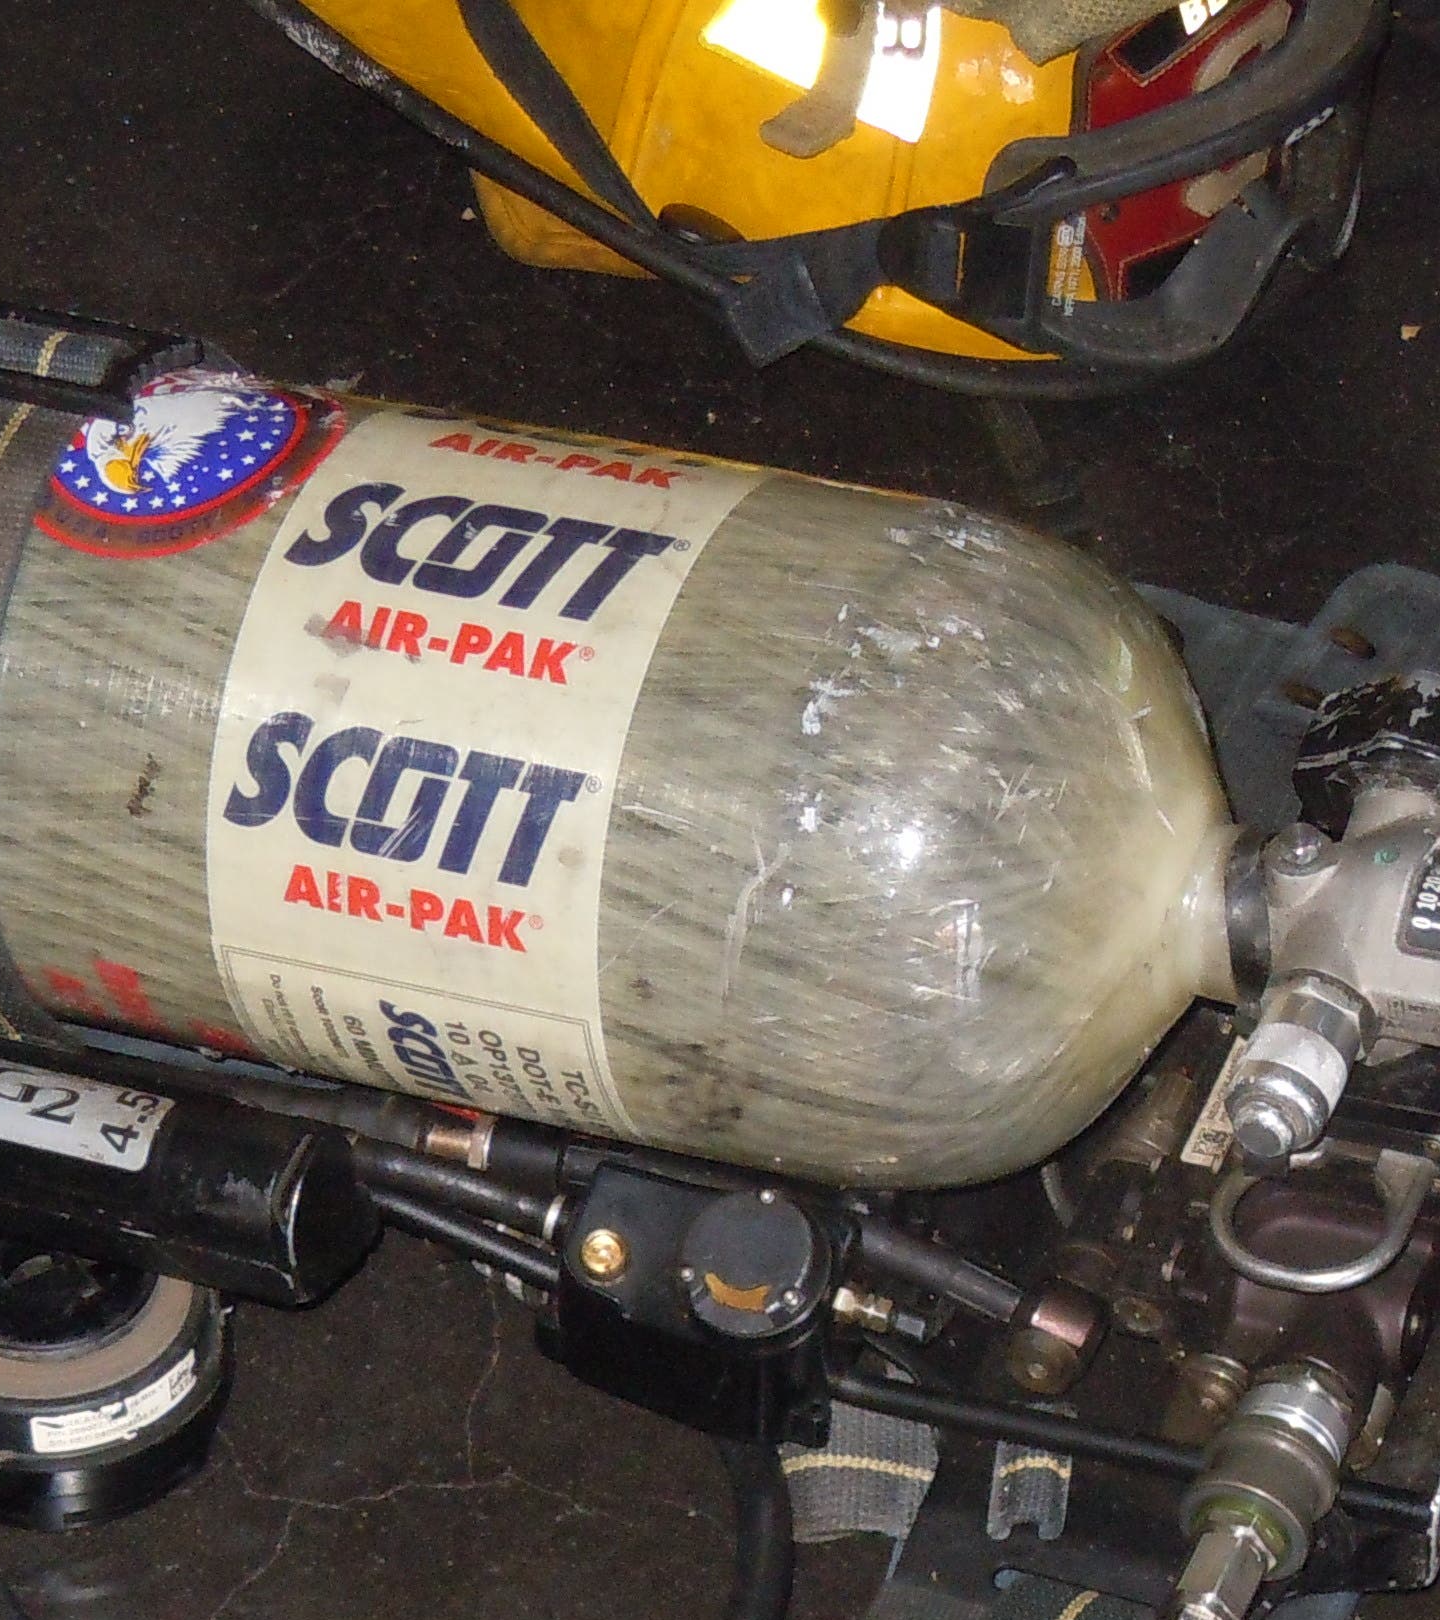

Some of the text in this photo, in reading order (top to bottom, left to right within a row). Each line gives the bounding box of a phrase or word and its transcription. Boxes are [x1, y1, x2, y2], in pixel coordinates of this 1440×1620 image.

[428, 431, 684, 489] AIR-PAK
[285, 482, 675, 622] SCOTT
[323, 599, 579, 685] AIR-PAK
[222, 711, 589, 887] SCOTT
[283, 864, 527, 953] AIR-PAK
[1416, 892, 1439, 911] 10
[379, 999, 474, 1102] SCOTT
